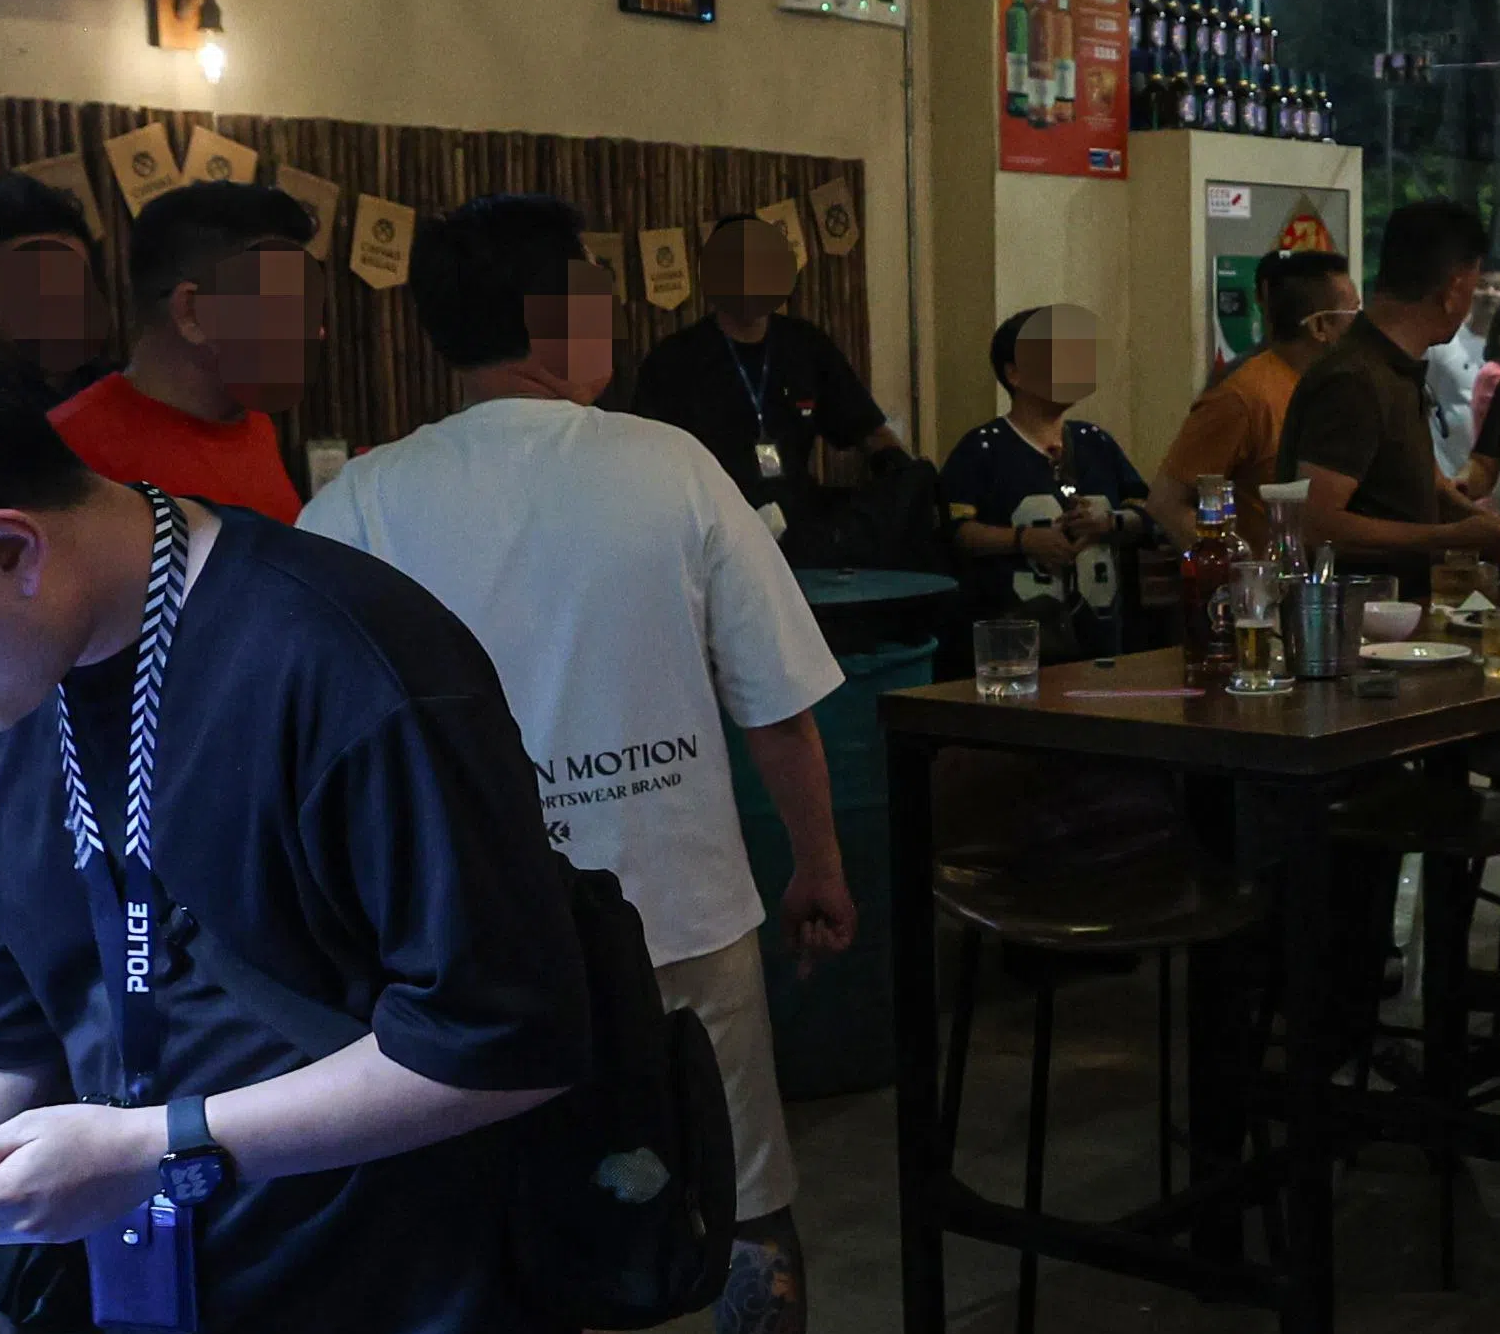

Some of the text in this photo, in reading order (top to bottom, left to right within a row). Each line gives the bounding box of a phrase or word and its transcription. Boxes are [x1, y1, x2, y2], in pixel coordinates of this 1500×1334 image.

[566, 734, 698, 781] MOTION
[632, 773, 683, 796] BRAND
[126, 901, 150, 993] POLICE
